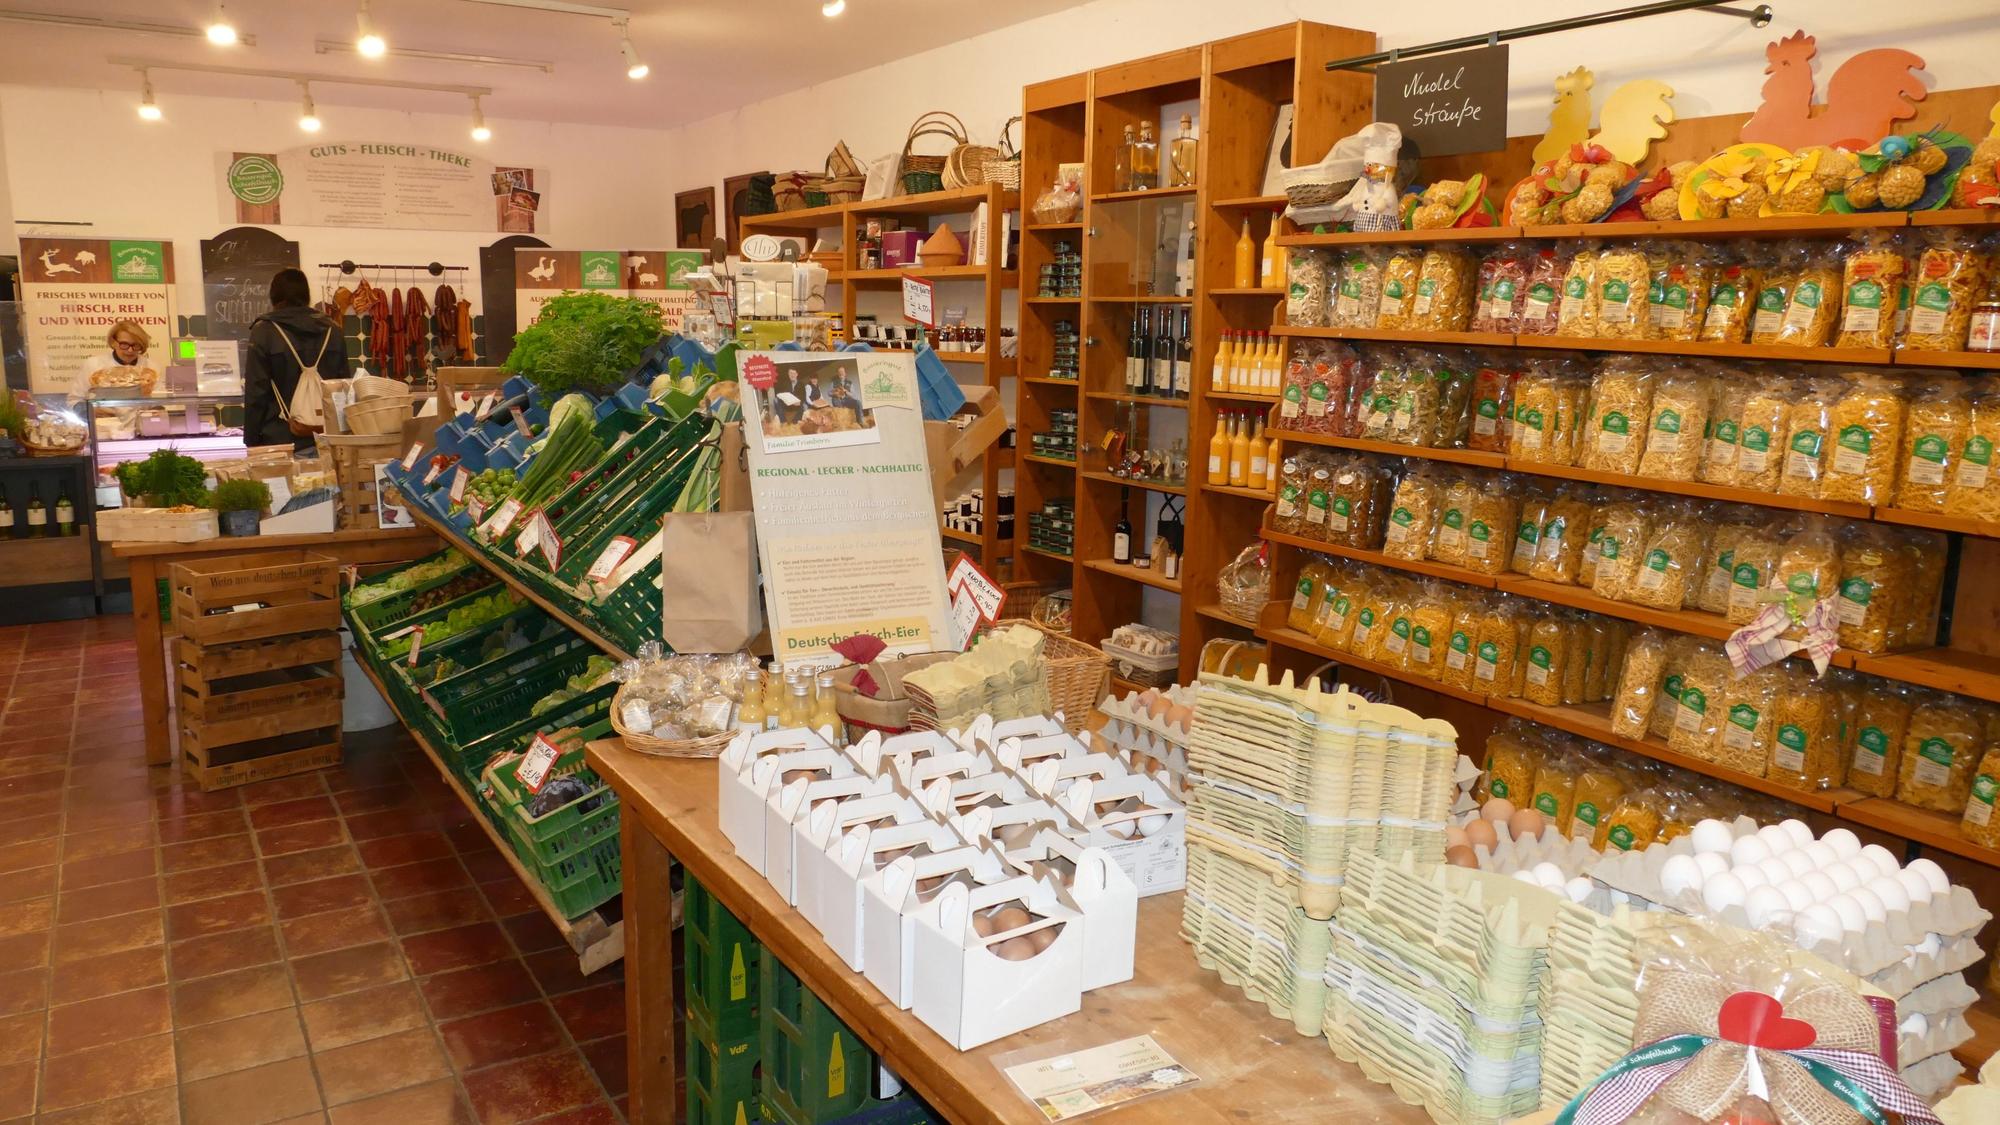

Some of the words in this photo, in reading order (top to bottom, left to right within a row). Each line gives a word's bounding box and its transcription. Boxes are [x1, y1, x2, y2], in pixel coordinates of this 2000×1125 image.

[1403, 66, 1465, 98] Nudel
[309, 144, 348, 158] GUTS
[360, 143, 416, 157] FLEISCH
[429, 149, 473, 169] THEKE
[36, 291, 86, 299] FRISCHES
[89, 291, 141, 300] WILDBRET
[143, 292, 165, 300] VON
[60, 303, 116, 314] HIRSCH,
[118, 304, 145, 313] REH
[39, 316, 69, 326] UND
[757, 468, 809, 477] REGIONAL
[817, 466, 854, 476] LECKER
[862, 463, 923, 474] NACHHALTIG
[729, 1043, 749, 1055] VdF
